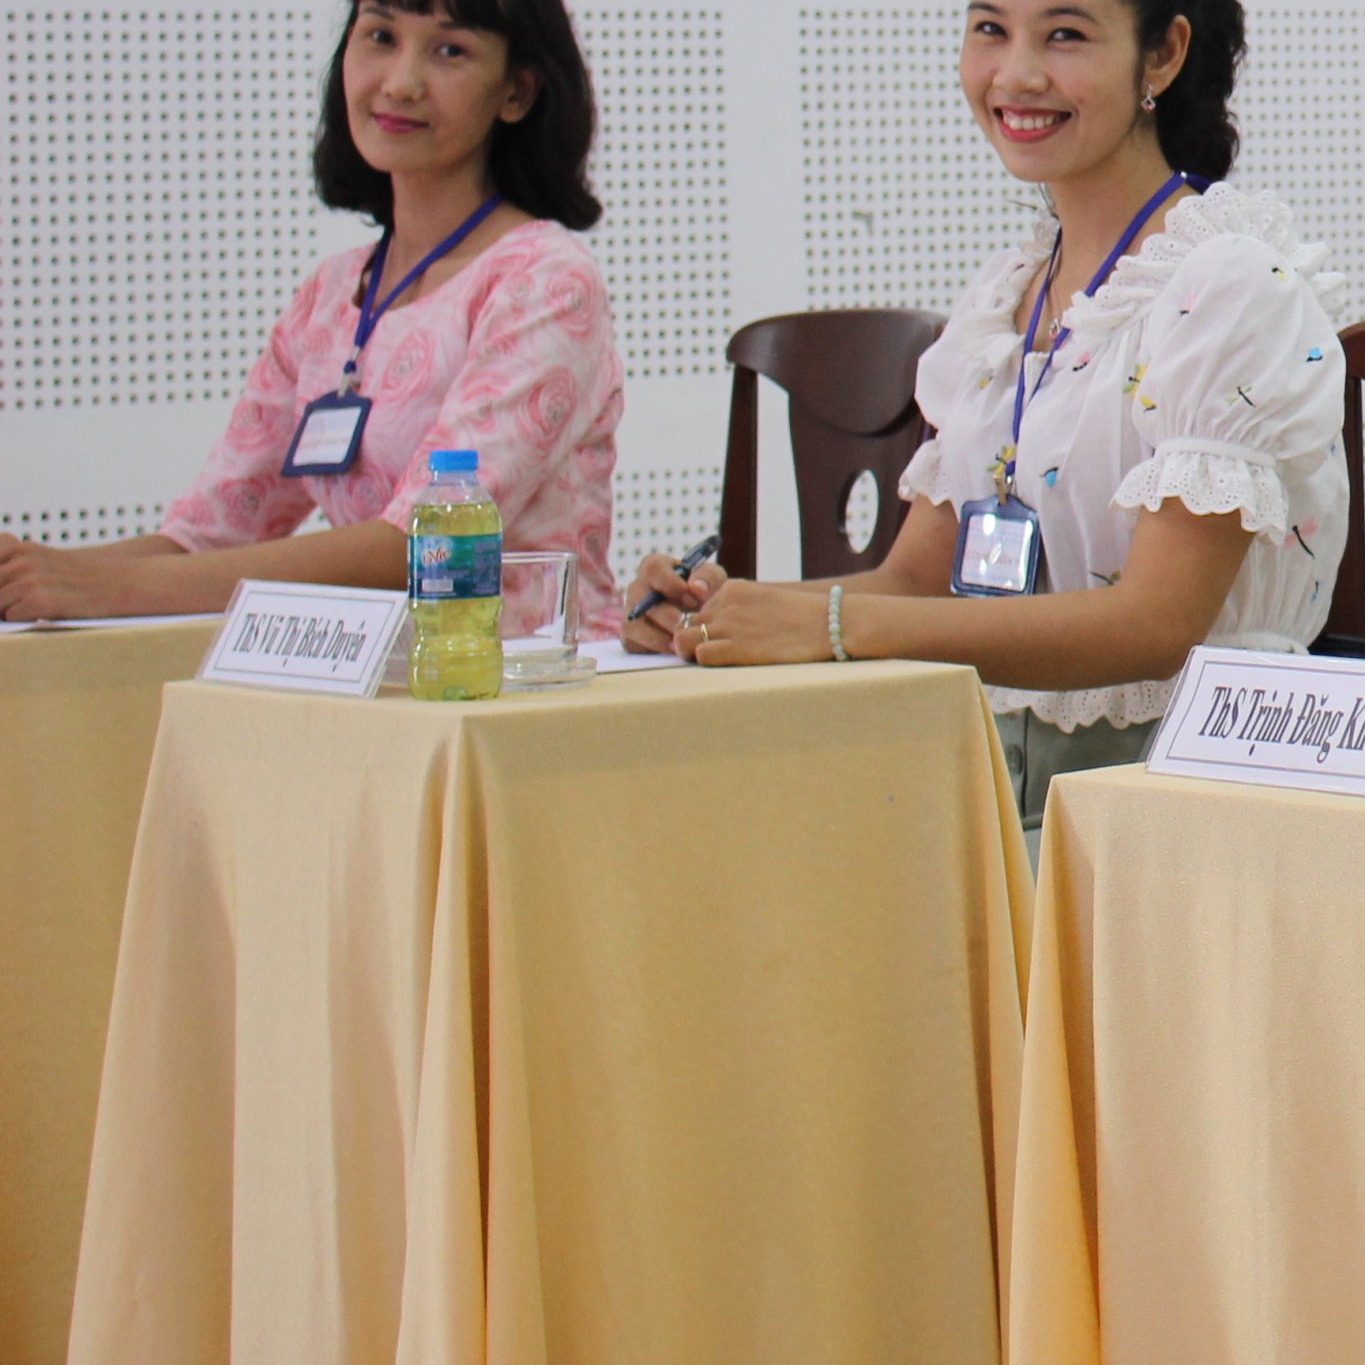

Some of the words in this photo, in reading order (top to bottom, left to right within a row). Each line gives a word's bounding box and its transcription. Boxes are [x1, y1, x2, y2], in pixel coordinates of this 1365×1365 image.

[232, 612, 267, 654] ThS
[274, 615, 306, 668] Thị
[1197, 685, 1247, 739] ThS
[1236, 689, 1294, 756] Trịnh
[1286, 693, 1345, 764] Đăng
